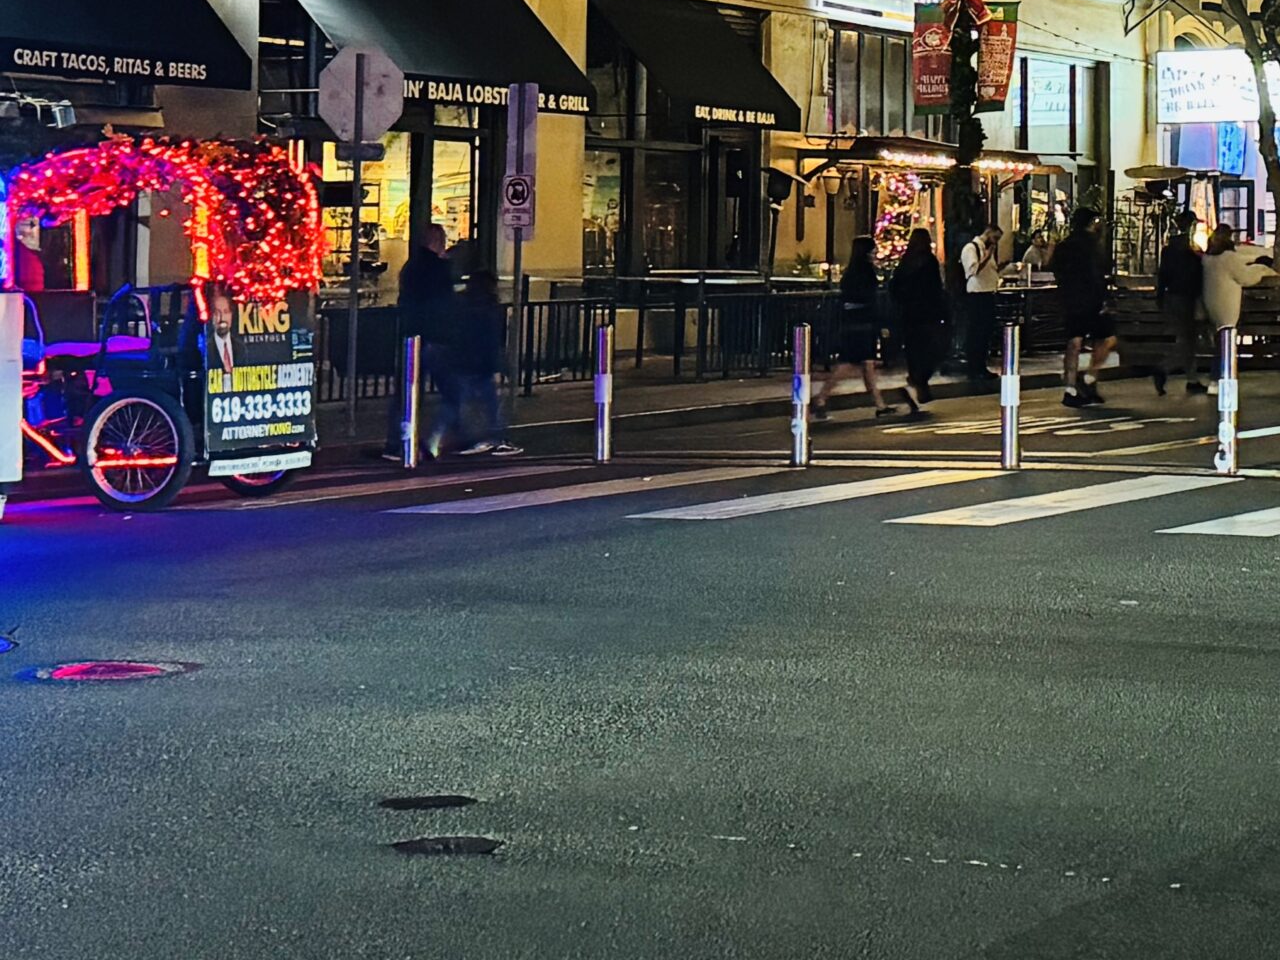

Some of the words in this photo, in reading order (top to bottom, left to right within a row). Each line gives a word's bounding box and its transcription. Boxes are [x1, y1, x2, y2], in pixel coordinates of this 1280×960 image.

[13, 48, 57, 68] CRAFT
[61, 52, 110, 75] TACOS,
[114, 57, 151, 75] RITAS
[154, 61, 164, 77] &
[168, 62, 207, 80] BEERS
[403, 79, 424, 98] IN'
[428, 82, 463, 102] BAJA
[466, 85, 510, 105] LOBST
[548, 94, 556, 109] &
[559, 95, 590, 112] GRILL
[712, 107, 738, 121] DRINK
[746, 111, 756, 123] BE
[757, 112, 776, 124] BAJA
[238, 301, 291, 335] KING
[232, 364, 278, 392] MOTORCYCLE
[212, 390, 312, 424] 619-333-3333
